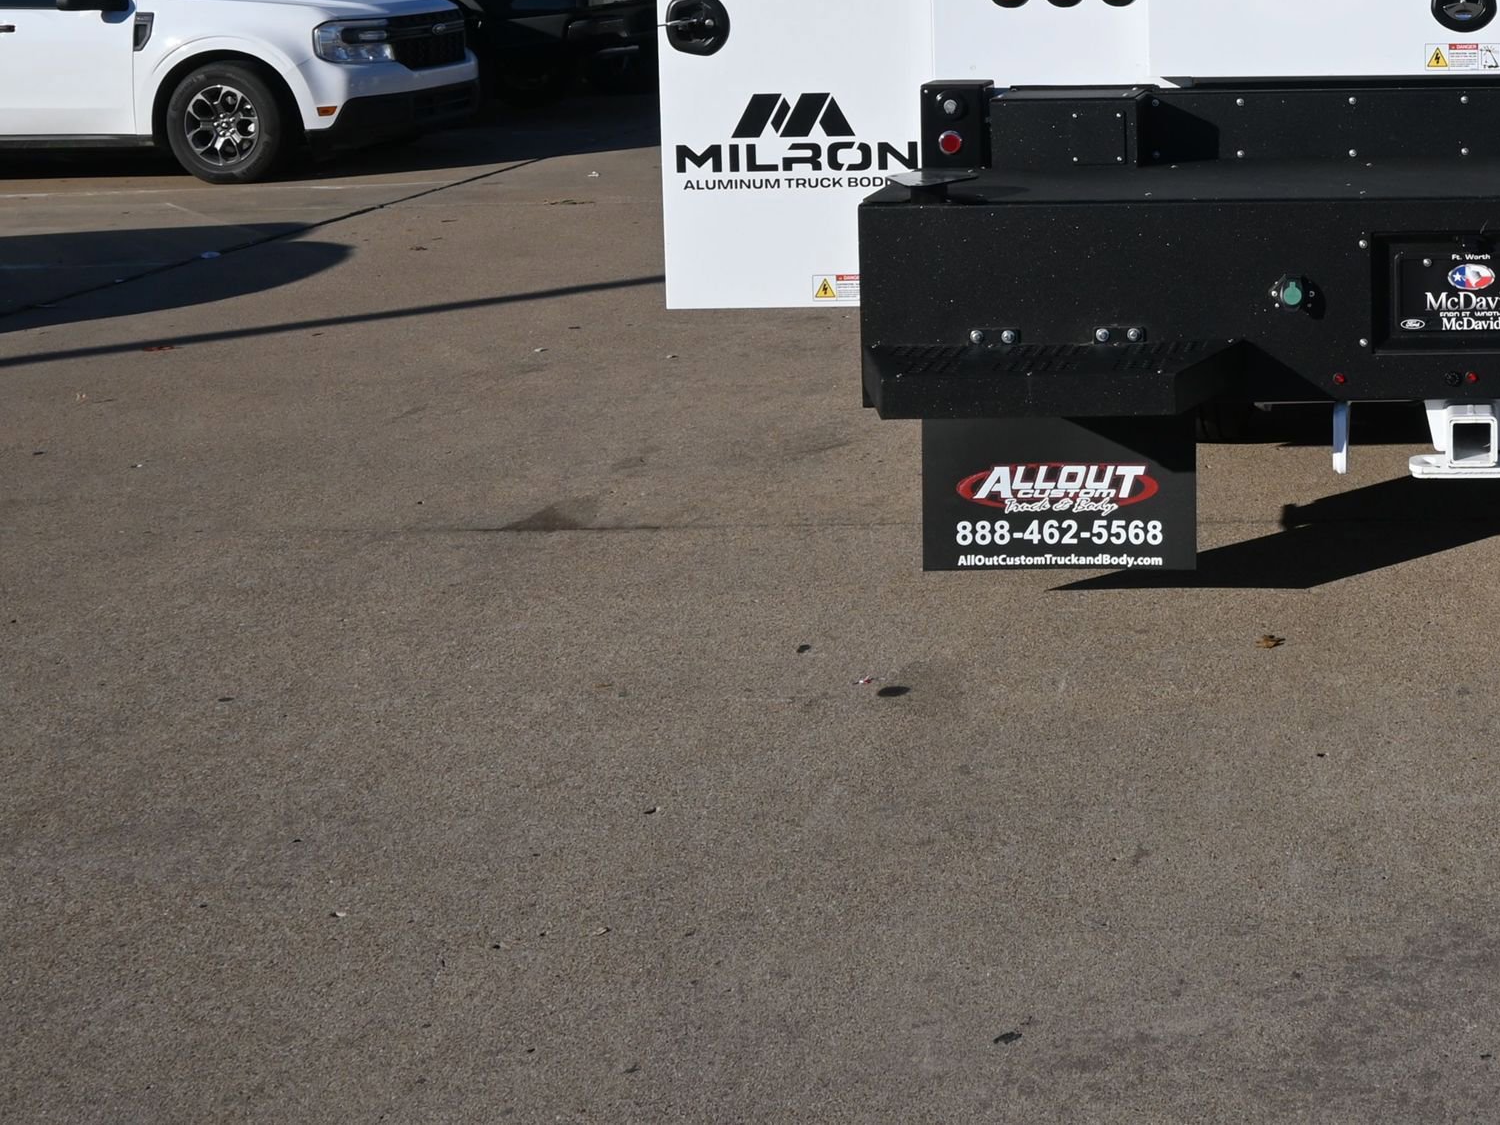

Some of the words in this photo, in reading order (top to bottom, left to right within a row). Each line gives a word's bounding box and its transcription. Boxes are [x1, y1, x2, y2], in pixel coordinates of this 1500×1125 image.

[676, 141, 918, 173] MILRON
[684, 179, 780, 190] ALUMINUM
[784, 177, 843, 188] TRUCK
[847, 176, 888, 187] BODI
[973, 465, 1145, 499] ALLOUT
[1004, 498, 1050, 514] Truck
[1052, 498, 1074, 512] &
[1073, 497, 1119, 516] Body
[956, 520, 1163, 545] 888-462-5568
[957, 554, 1163, 567] AllOutCustomTruckandBody.com
